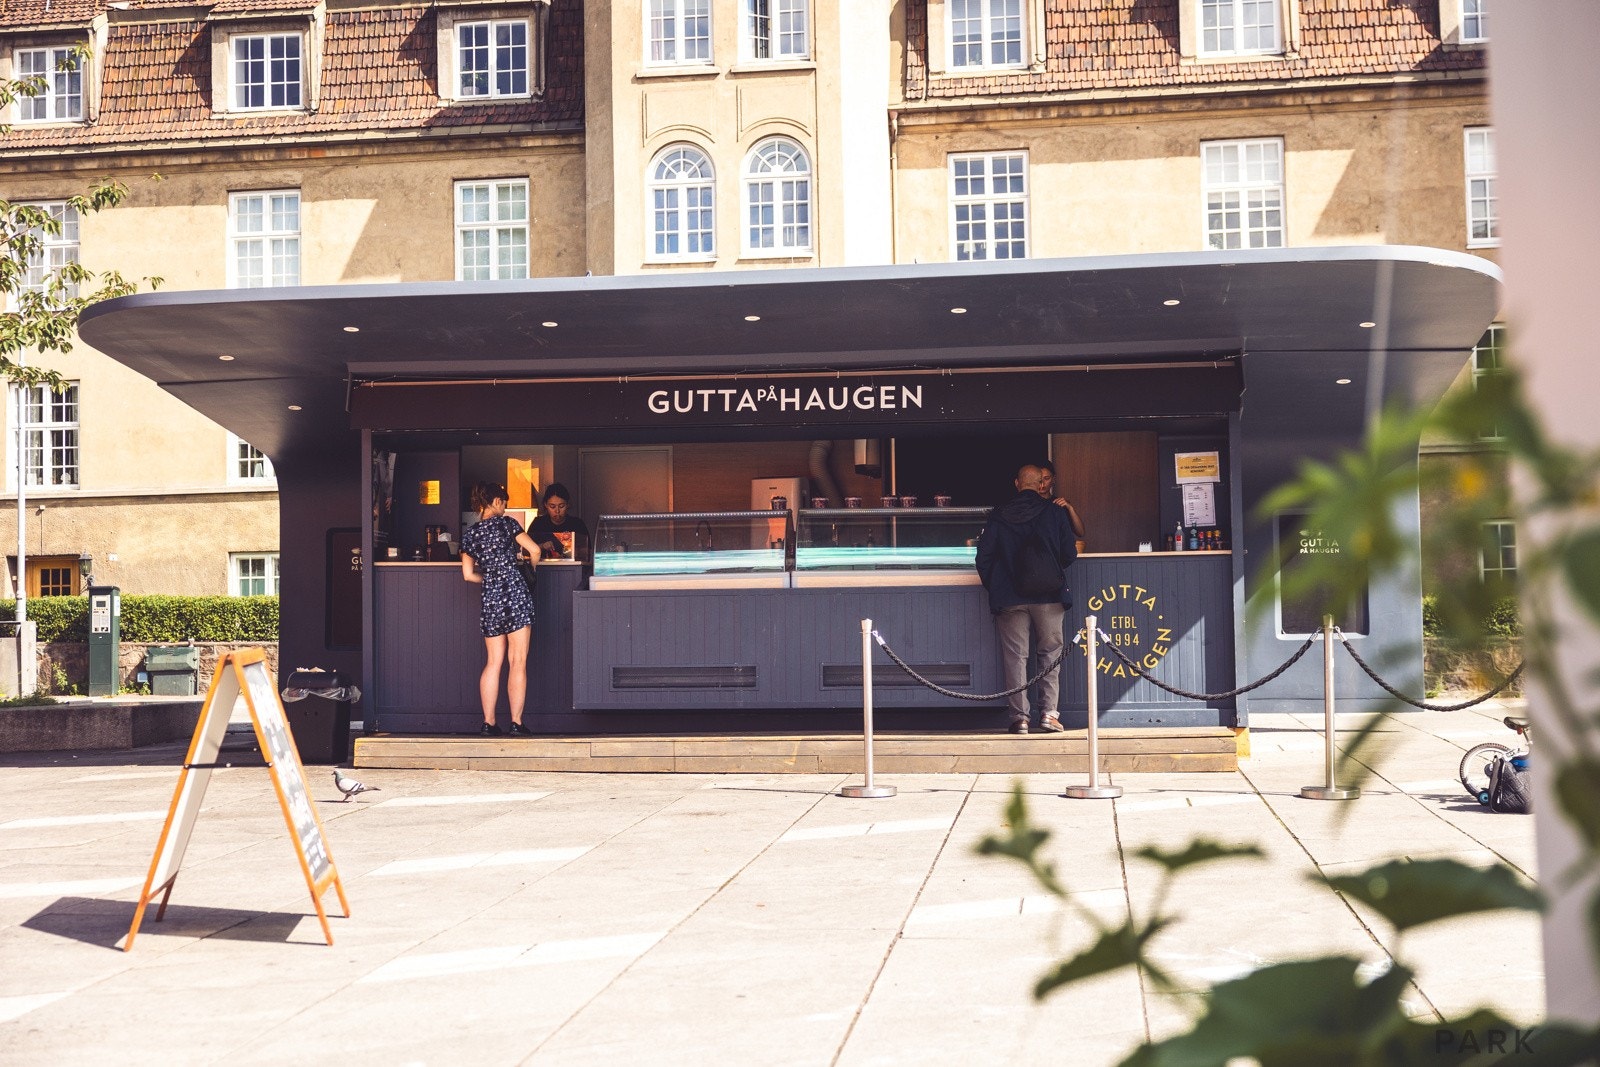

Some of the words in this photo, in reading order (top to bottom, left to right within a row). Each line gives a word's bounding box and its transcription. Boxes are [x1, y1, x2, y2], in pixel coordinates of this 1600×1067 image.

[647, 389, 758, 414] GUTTA
[757, 385, 778, 402] PÅ
[780, 385, 923, 412] HAUGEN
[1088, 584, 1156, 611] GUTTA
[1111, 616, 1137, 629] ETBL
[1097, 628, 1172, 678] HAUGEN
